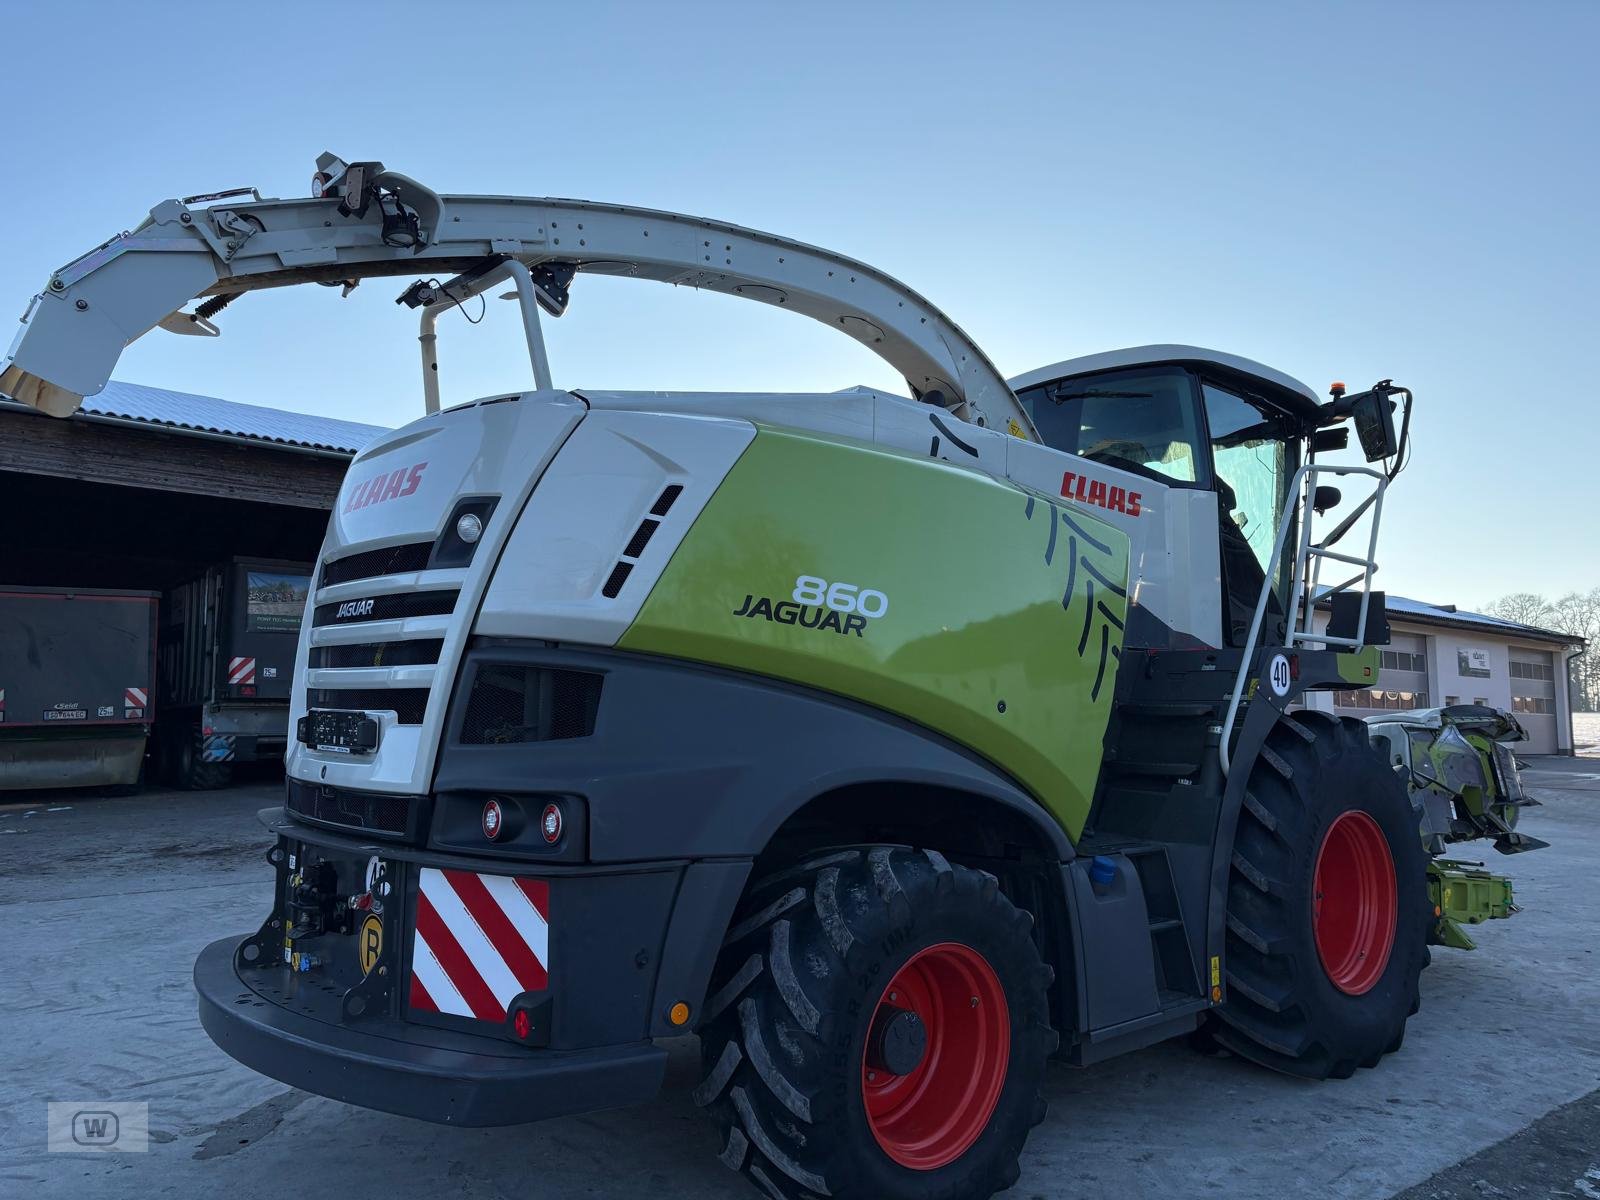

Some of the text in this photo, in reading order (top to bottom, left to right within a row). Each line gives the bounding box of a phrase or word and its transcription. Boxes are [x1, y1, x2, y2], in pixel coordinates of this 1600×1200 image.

[343, 461, 428, 514] CLAAS
[1060, 470, 1143, 517] CLAAS
[335, 599, 375, 619] JAGUAR
[733, 594, 867, 638] JAGUAR
[792, 575, 889, 619] 860
[1273, 660, 1288, 688] 40
[366, 927, 380, 967] R
